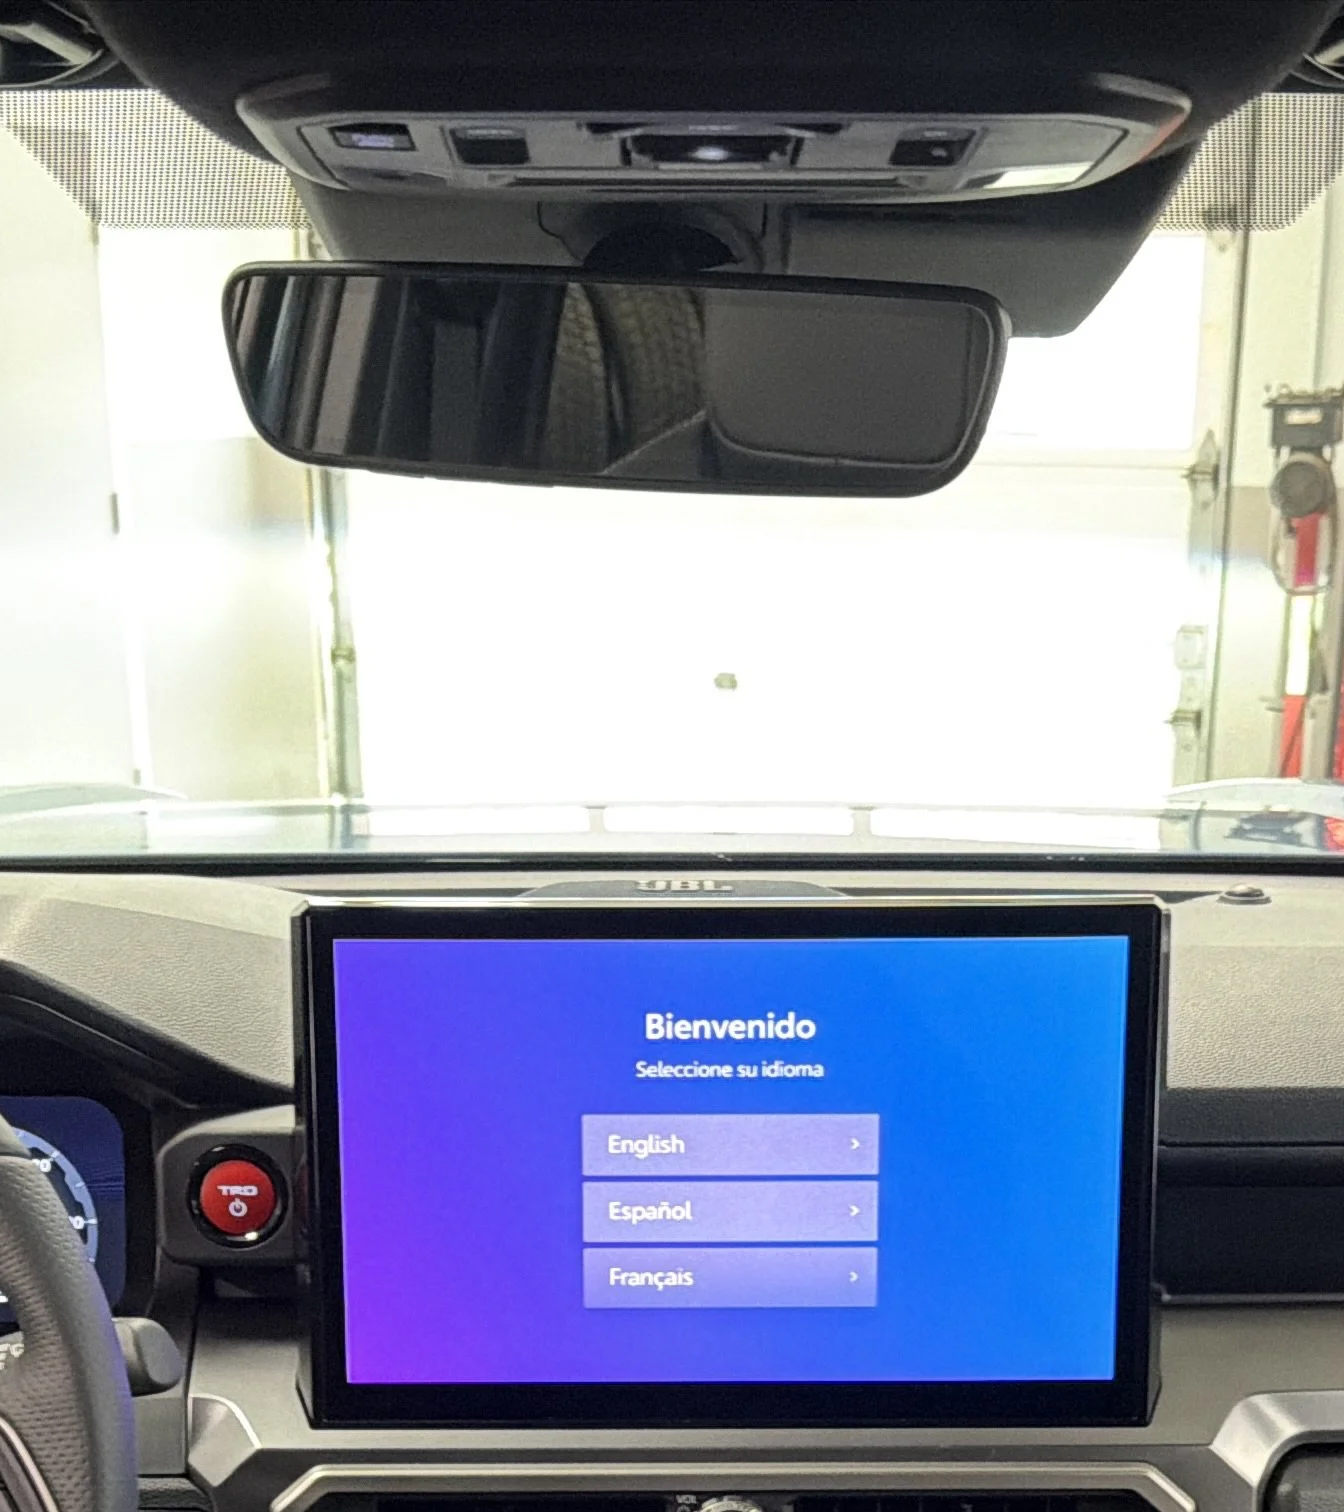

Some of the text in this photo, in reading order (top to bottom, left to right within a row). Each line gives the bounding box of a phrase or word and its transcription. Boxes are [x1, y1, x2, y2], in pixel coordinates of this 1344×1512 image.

[636, 880, 734, 891] JBL
[644, 1013, 817, 1040] Bienvenido
[635, 1059, 825, 1081] Seleccione su idioma
[608, 1135, 685, 1160] English
[217, 1185, 258, 1196] TRD
[609, 1200, 692, 1224] Español
[609, 1267, 694, 1291] Français
[676, 1495, 697, 1504] VOL
